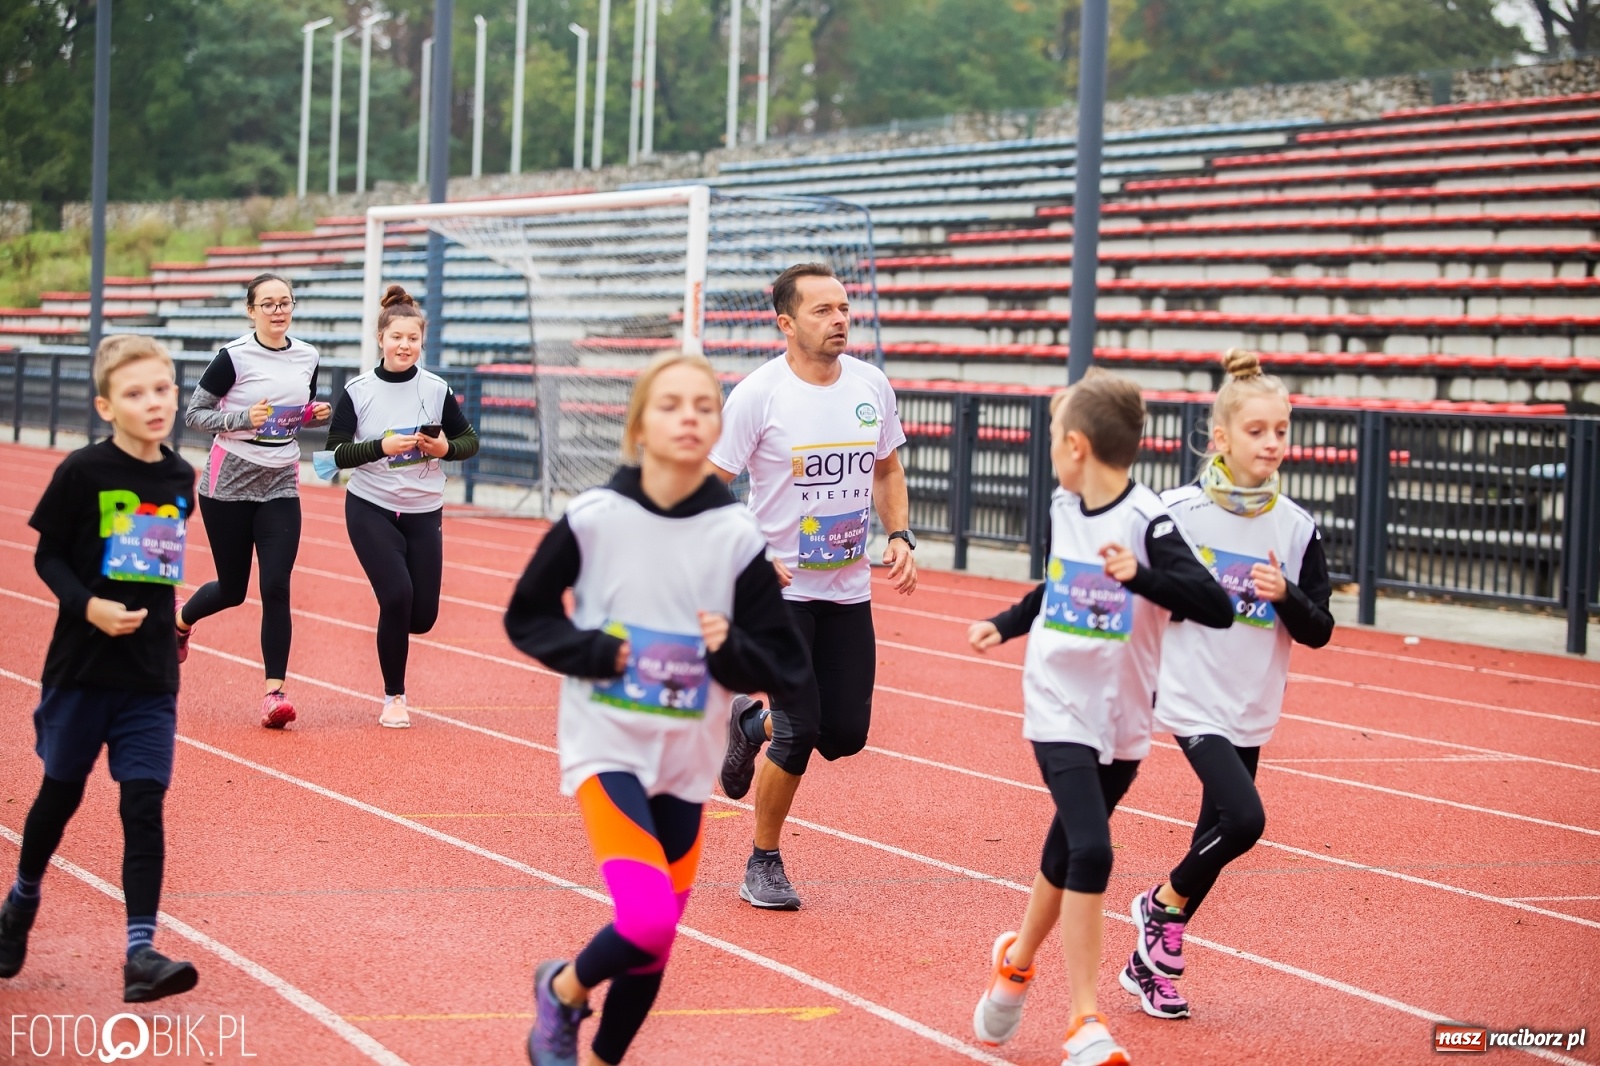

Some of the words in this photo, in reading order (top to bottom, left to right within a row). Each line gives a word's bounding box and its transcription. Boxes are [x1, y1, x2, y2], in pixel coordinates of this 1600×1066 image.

[794, 452, 875, 486] agro
[802, 488, 869, 501] KIETRZ
[810, 534, 826, 542] BIEG
[829, 533, 842, 541] DLA
[844, 545, 861, 560] 273
[1222, 574, 1240, 586] DLA
[1236, 600, 1267, 618] 096
[1086, 612, 1124, 632] 056
